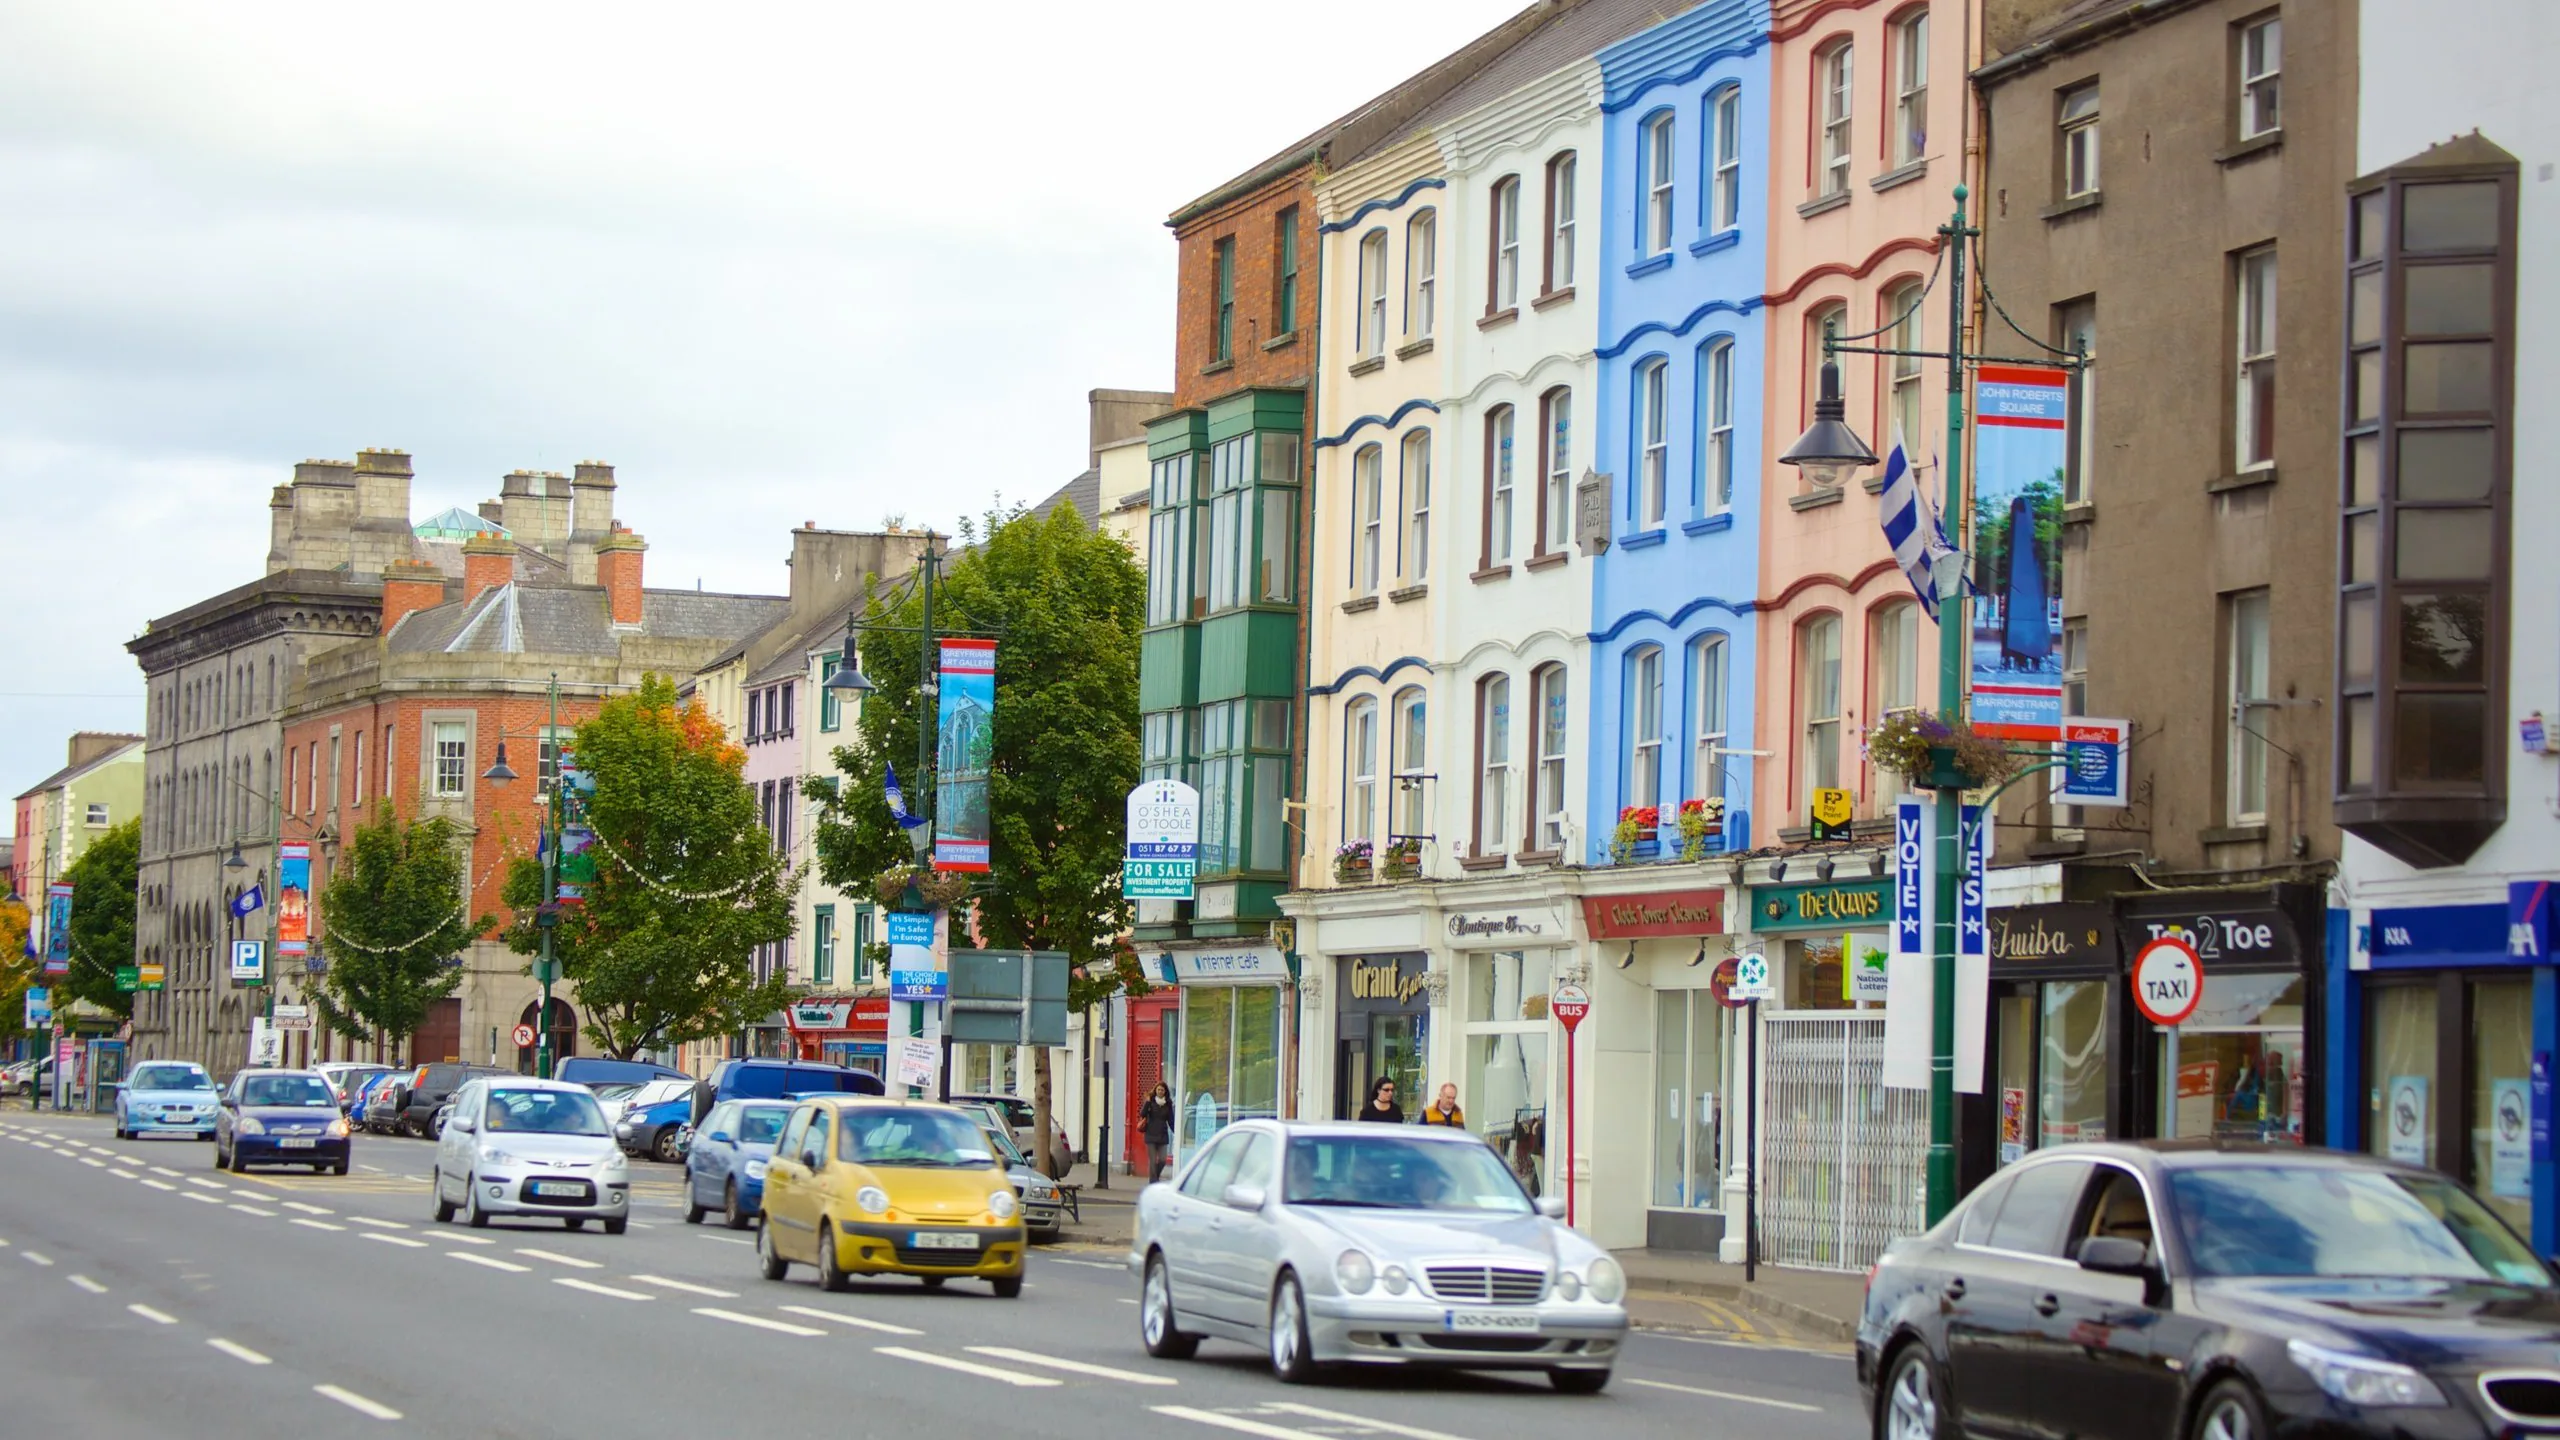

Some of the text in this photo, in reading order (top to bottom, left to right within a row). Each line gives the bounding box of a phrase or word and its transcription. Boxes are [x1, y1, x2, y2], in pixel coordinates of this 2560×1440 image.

[1980, 388, 2064, 401] JOHN ROBERTS
[1999, 402, 2044, 414] SQUARE
[943, 649, 993, 658] GREYFRIARS
[1976, 698, 2059, 710] BARRONSTRAND
[1997, 710, 2037, 721] STREET
[1138, 806, 1191, 818] O'SHEA
[1138, 818, 1191, 829] O'TOOLE
[941, 846, 985, 854] GREYFRIARS
[1138, 845, 1192, 853] 051 87 67 57
[1900, 818, 1920, 908] VOTE
[1962, 821, 1981, 906] YES
[1126, 863, 1191, 877] FOR SALE
[1126, 878, 1190, 886] INVESTMENT PROPERTY
[1637, 903, 1669, 925] Tower
[908, 925, 928, 933] Safer
[1449, 913, 1503, 937] Boutique
[2197, 915, 2220, 959] 2
[2220, 920, 2273, 950] Toe
[914, 971, 938, 979] CHOICE
[1351, 957, 1399, 999] Grant
[906, 986, 925, 995] YES
[2146, 979, 2188, 1001] TAXI
[1559, 1005, 1583, 1016] BUS
